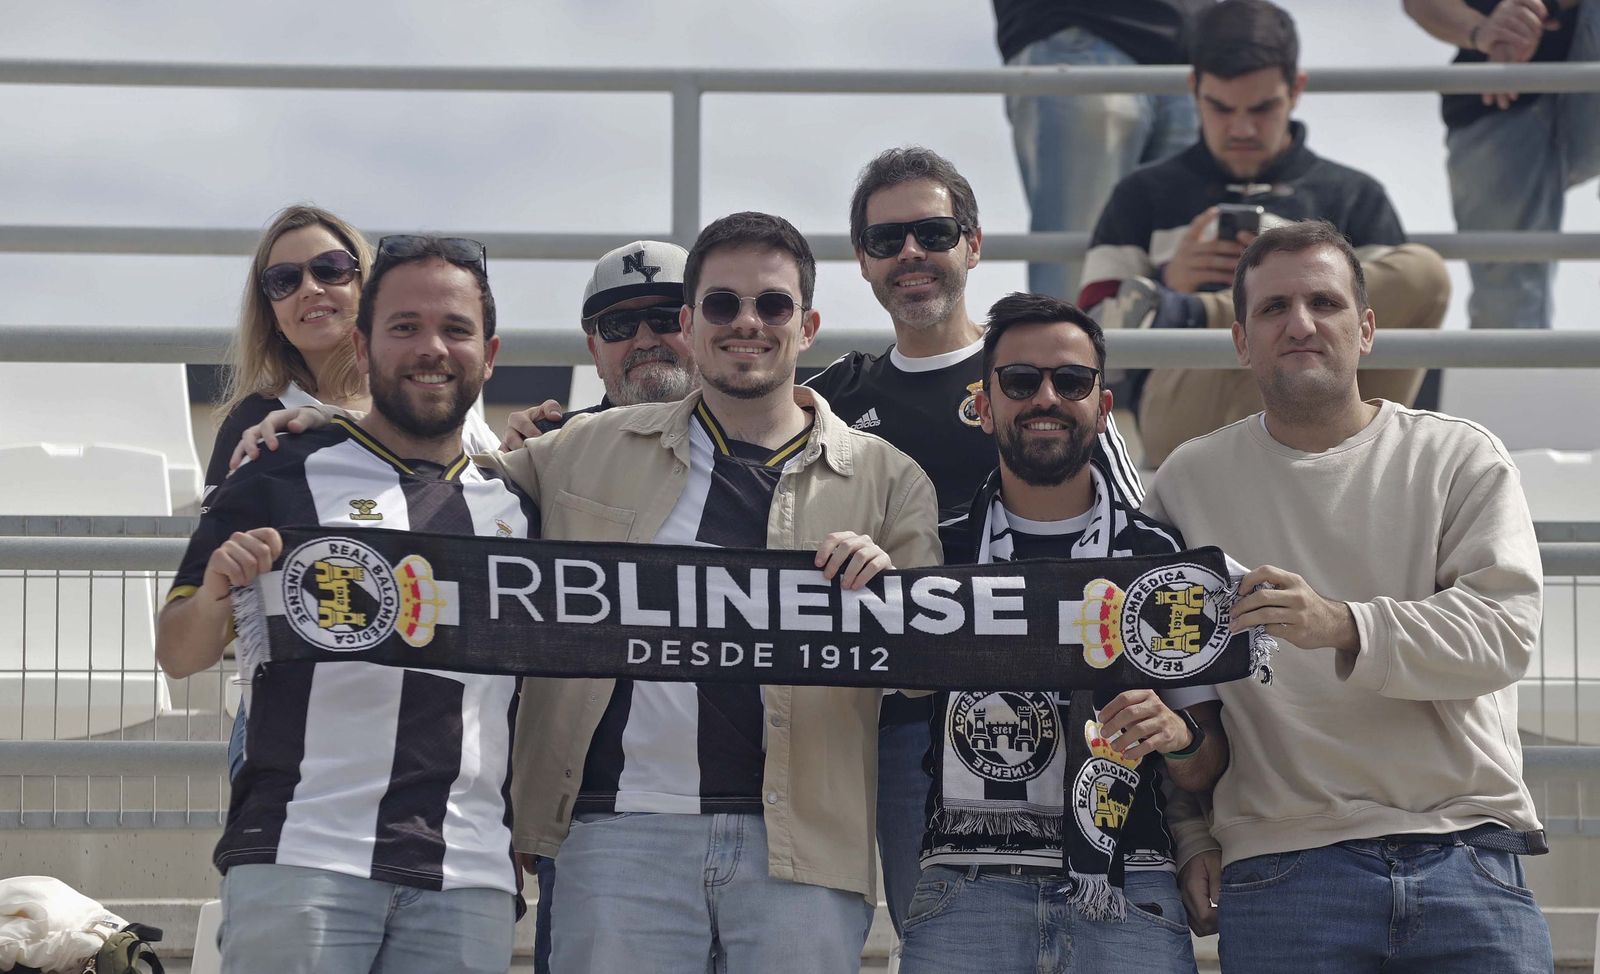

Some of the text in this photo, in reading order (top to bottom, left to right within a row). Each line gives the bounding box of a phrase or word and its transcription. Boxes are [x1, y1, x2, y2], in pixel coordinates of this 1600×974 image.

[622, 250, 661, 283] NY
[851, 419, 881, 430] adidas
[329, 543, 369, 565] REAL
[287, 560, 310, 626] LINENSE
[336, 586, 345, 606] 1912
[1174, 610, 1183, 630] 1912
[1209, 604, 1231, 650] LINEN
[627, 639, 889, 671] DESDE 1912
[1145, 655, 1184, 672] REAL
[1078, 774, 1094, 809] REAL
